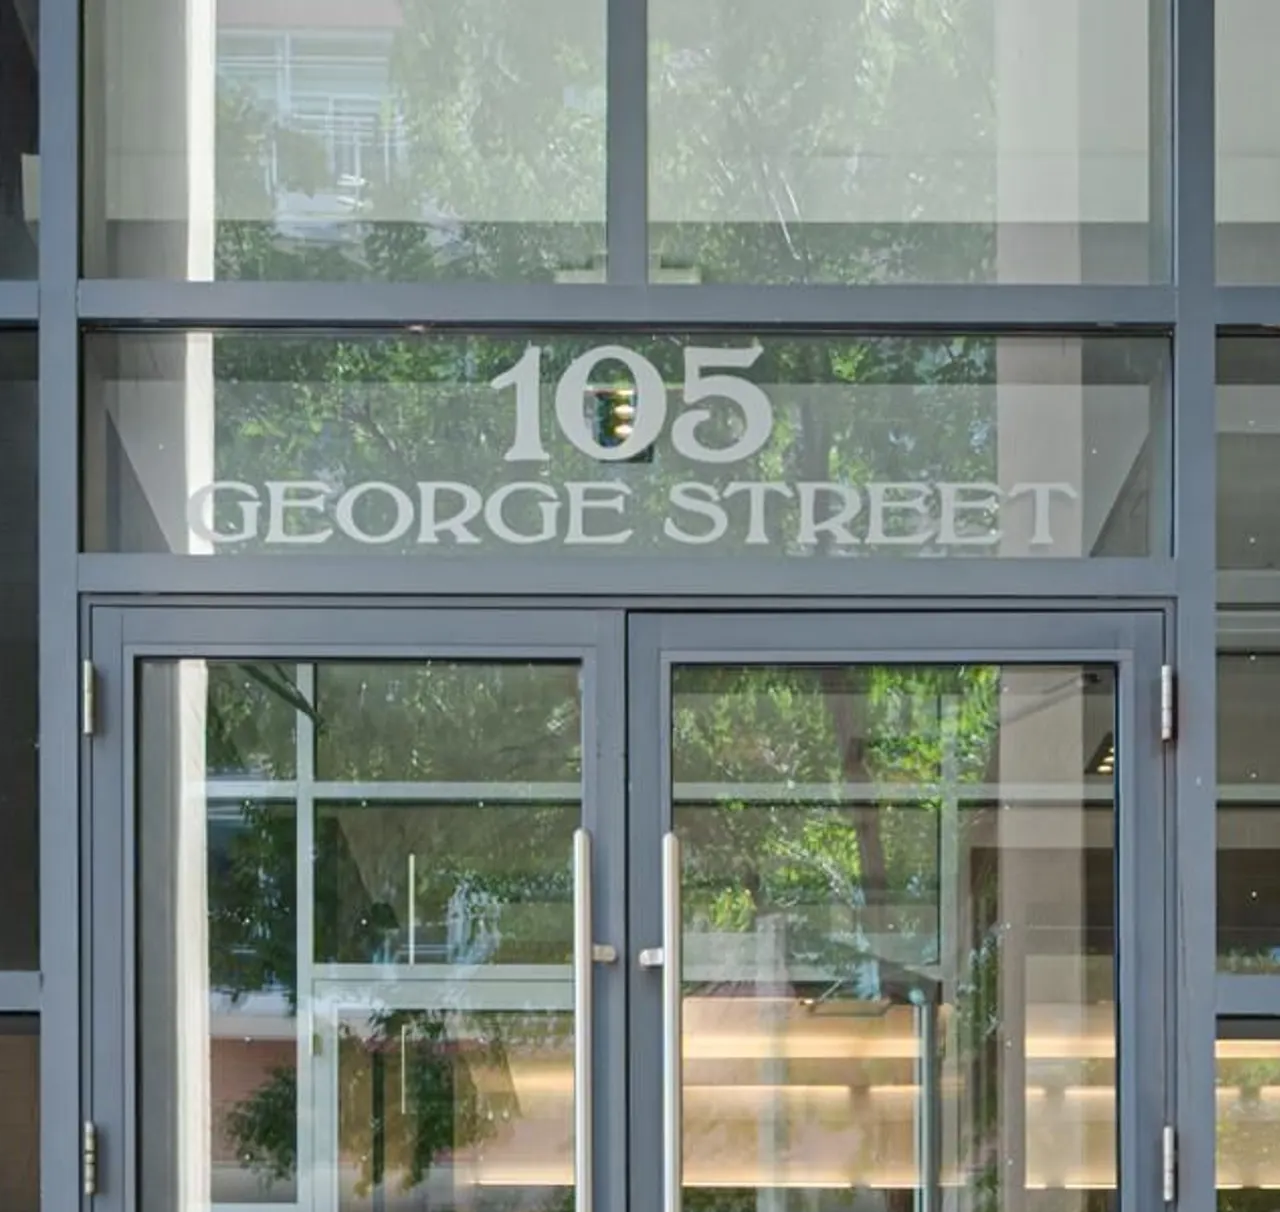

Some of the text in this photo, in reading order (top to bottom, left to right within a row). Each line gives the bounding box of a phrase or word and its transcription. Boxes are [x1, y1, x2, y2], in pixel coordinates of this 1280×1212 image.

[491, 343, 773, 464] 105
[186, 480, 1078, 545] GEORGE STREET
